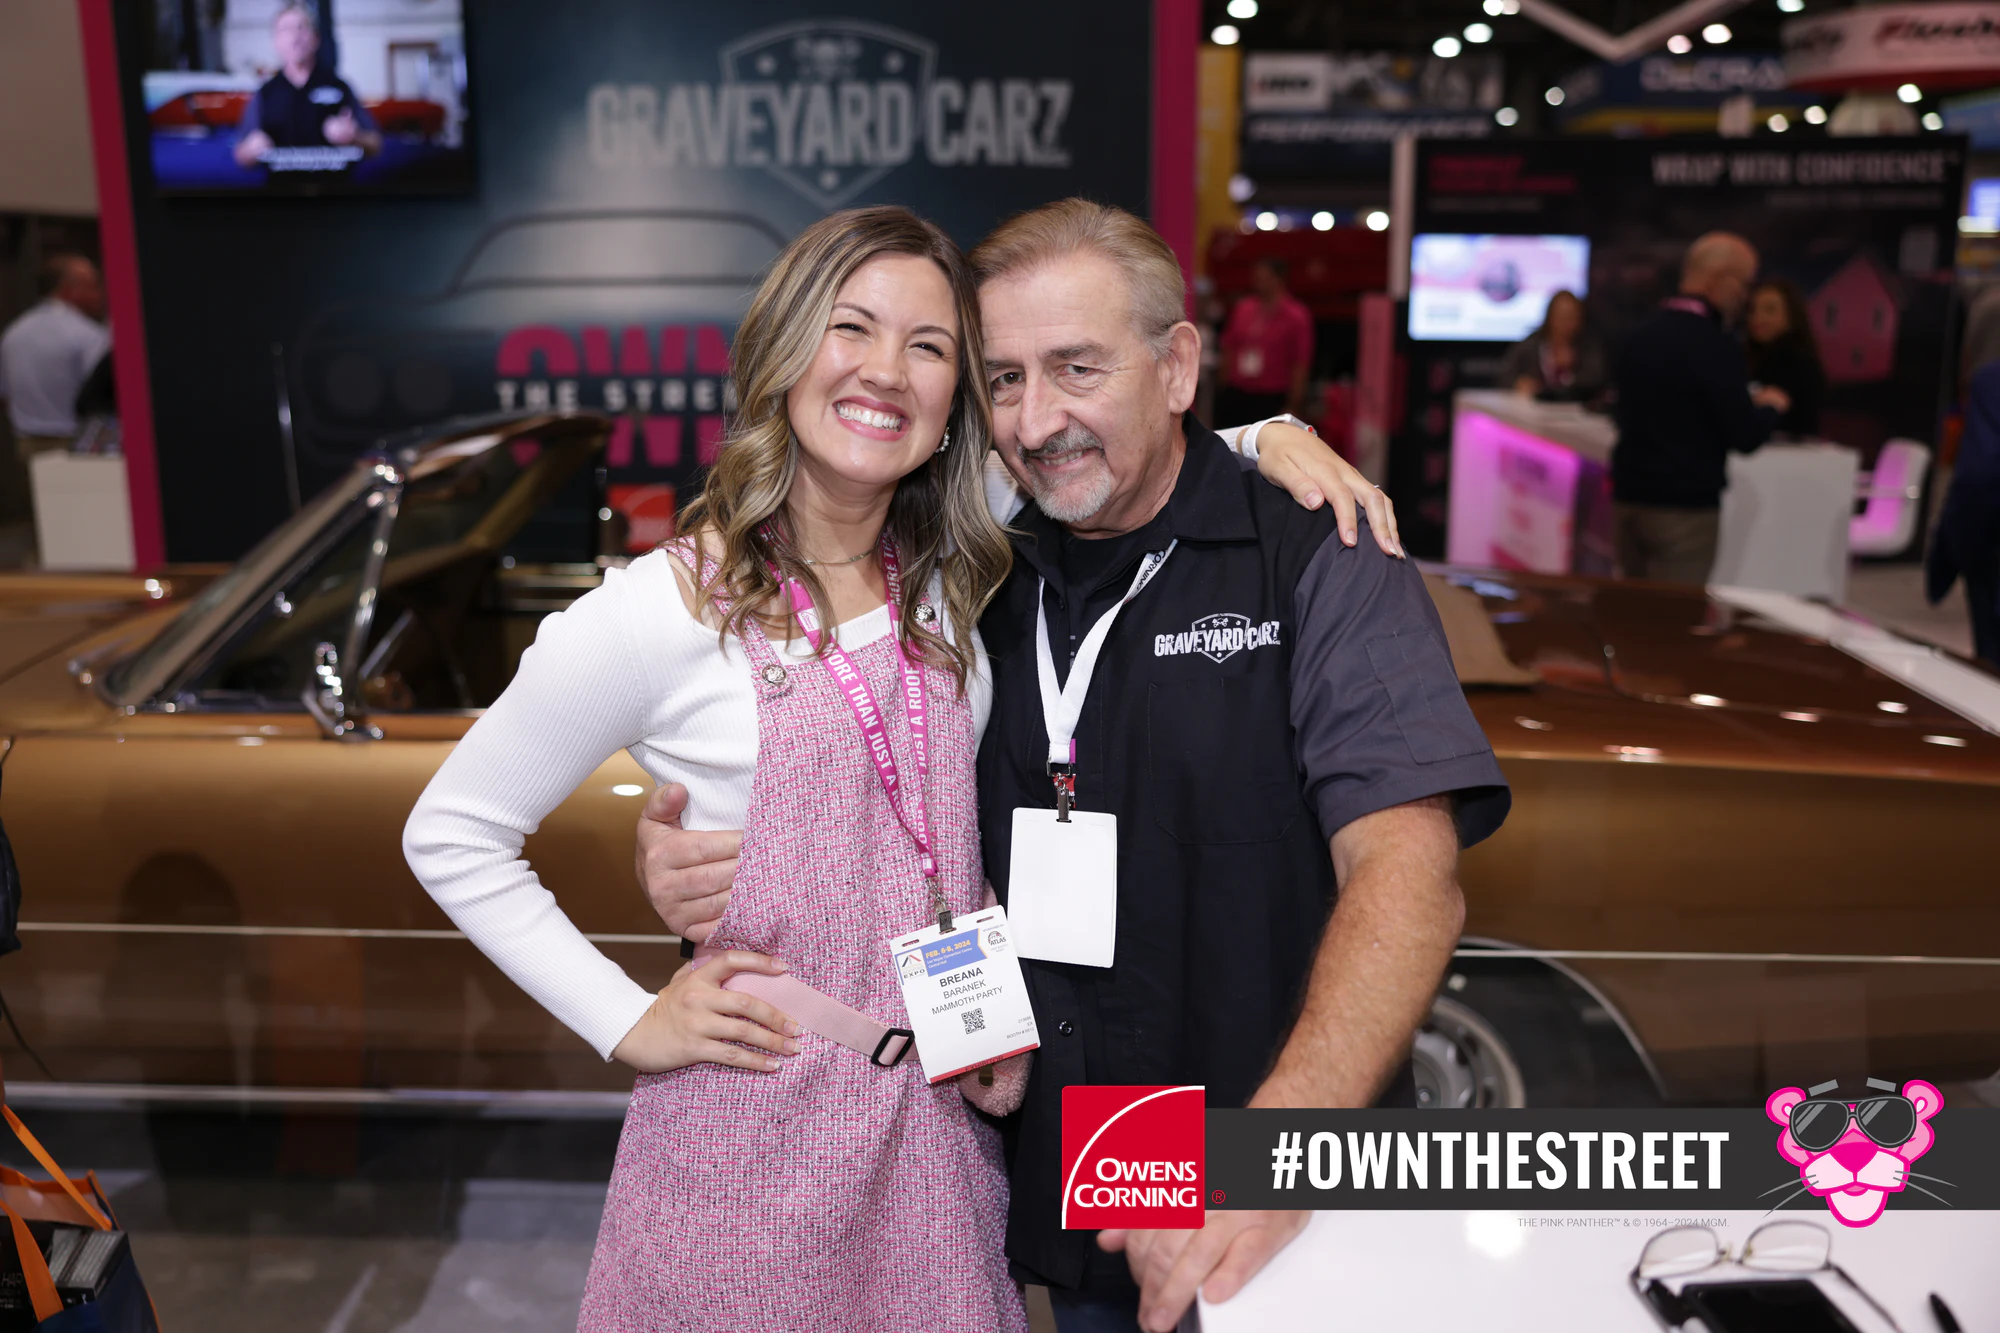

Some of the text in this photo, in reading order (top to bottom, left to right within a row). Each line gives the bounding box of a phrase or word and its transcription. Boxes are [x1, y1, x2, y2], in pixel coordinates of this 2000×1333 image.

[586, 78, 1074, 167] GRAVEYARD CARZ
[1729, 153, 1790, 184] WITH
[496, 378, 740, 416] THE STRE
[1154, 621, 1281, 657] GRAVEYARD CARZ
[904, 666, 923, 710] ROOF
[848, 683, 879, 729] THAN
[868, 732, 893, 769] JUST
[886, 774, 897, 786] A
[910, 715, 923, 726] A
[912, 731, 927, 768] JUST
[917, 809, 931, 850] ROO
[925, 949, 940, 959] FEB.
[954, 940, 971, 950] 2024
[990, 936, 1007, 946] ATLAS
[903, 968, 926, 979] EXPO
[939, 967, 984, 988] BREANA
[943, 979, 987, 999] BARANEK
[931, 986, 1003, 1015] MAMMOTH PARTY
